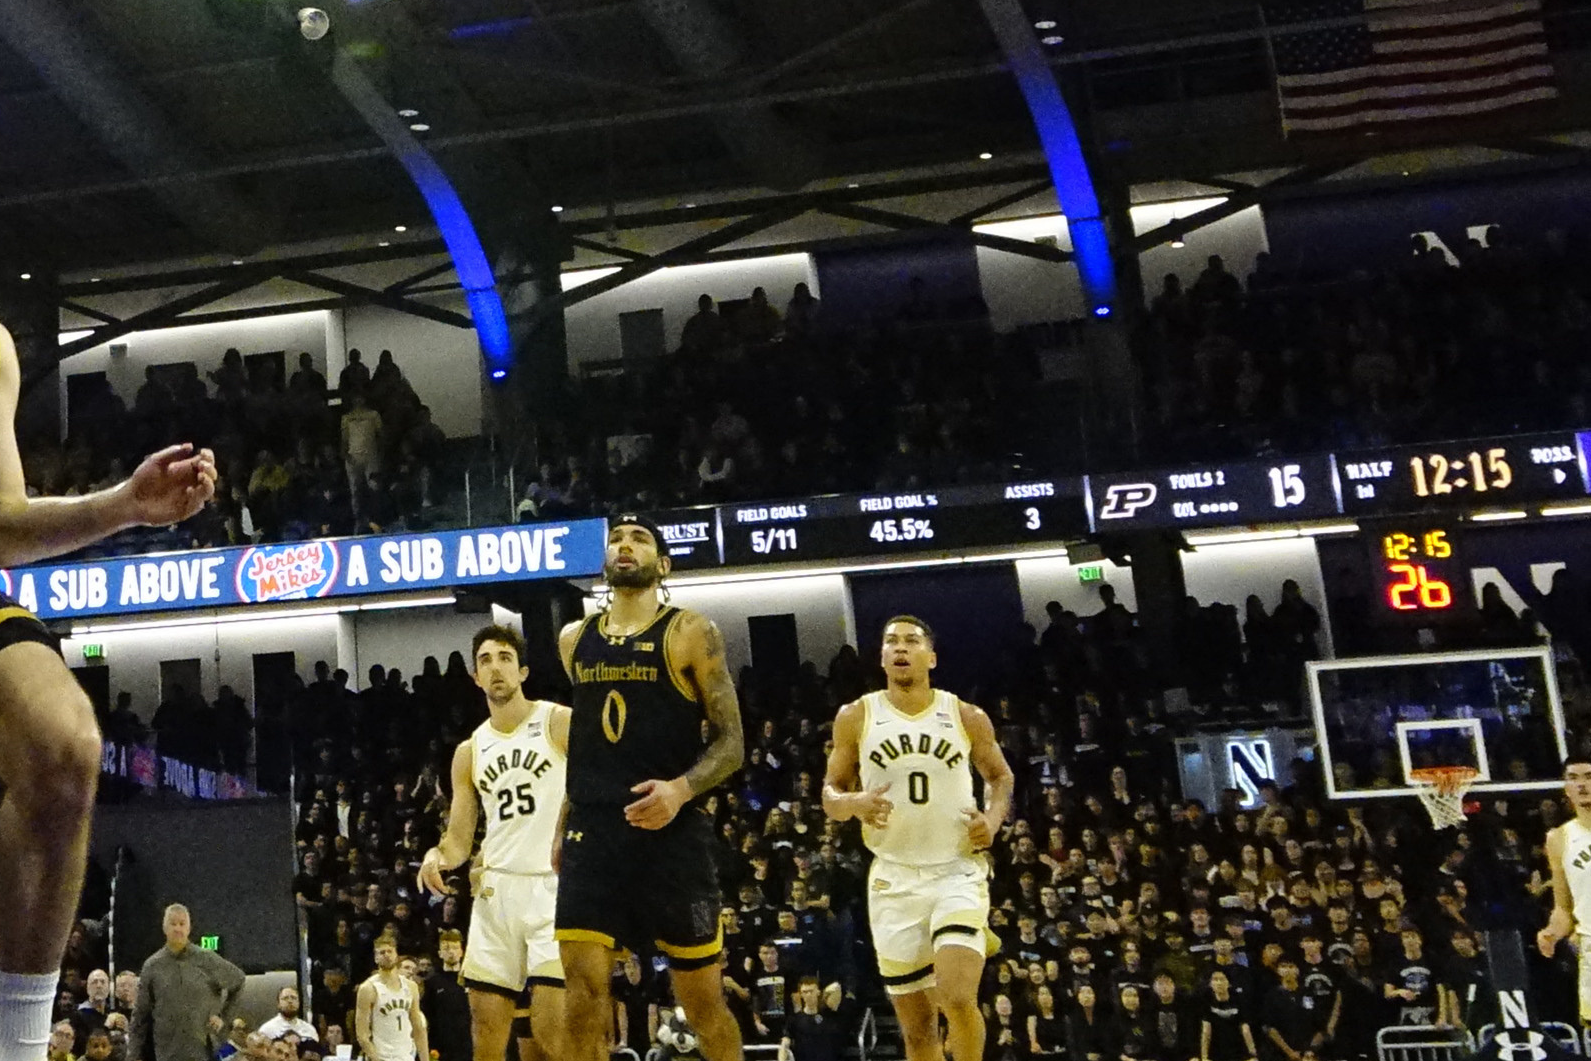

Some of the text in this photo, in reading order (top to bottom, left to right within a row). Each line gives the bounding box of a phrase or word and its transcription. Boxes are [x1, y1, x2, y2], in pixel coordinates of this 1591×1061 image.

[1169, 471, 1226, 489] FOULS 2
[1268, 464, 1305, 508] 15
[1345, 461, 1392, 479] HALF
[1411, 448, 1512, 497] 12:15
[860, 496, 891, 512] FIELD
[894, 494, 925, 510] GOAL
[1006, 483, 1054, 500] ASSISTS
[737, 504, 807, 522] FIELD GOALS
[1025, 508, 1040, 530] 3
[657, 522, 710, 540] RUST
[751, 528, 797, 554] 5/11
[870, 518, 934, 543] 45.5%
[1385, 530, 1452, 560] 12:15
[248, 543, 324, 579] Jersey
[347, 528, 566, 586] A SUB ABOVE
[19, 573, 38, 613] A
[49, 567, 107, 610] SUB
[120, 560, 220, 605] ABOVE
[1387, 564, 1452, 610] 26
[575, 661, 658, 683] Northwestern
[602, 690, 627, 744] 0
[869, 733, 964, 771] PURDUE
[478, 748, 553, 795] PURDUE
[496, 783, 536, 822] 25
[907, 771, 929, 805] 0
[396, 1015, 403, 1032] 1
[1498, 990, 1530, 1028] N
